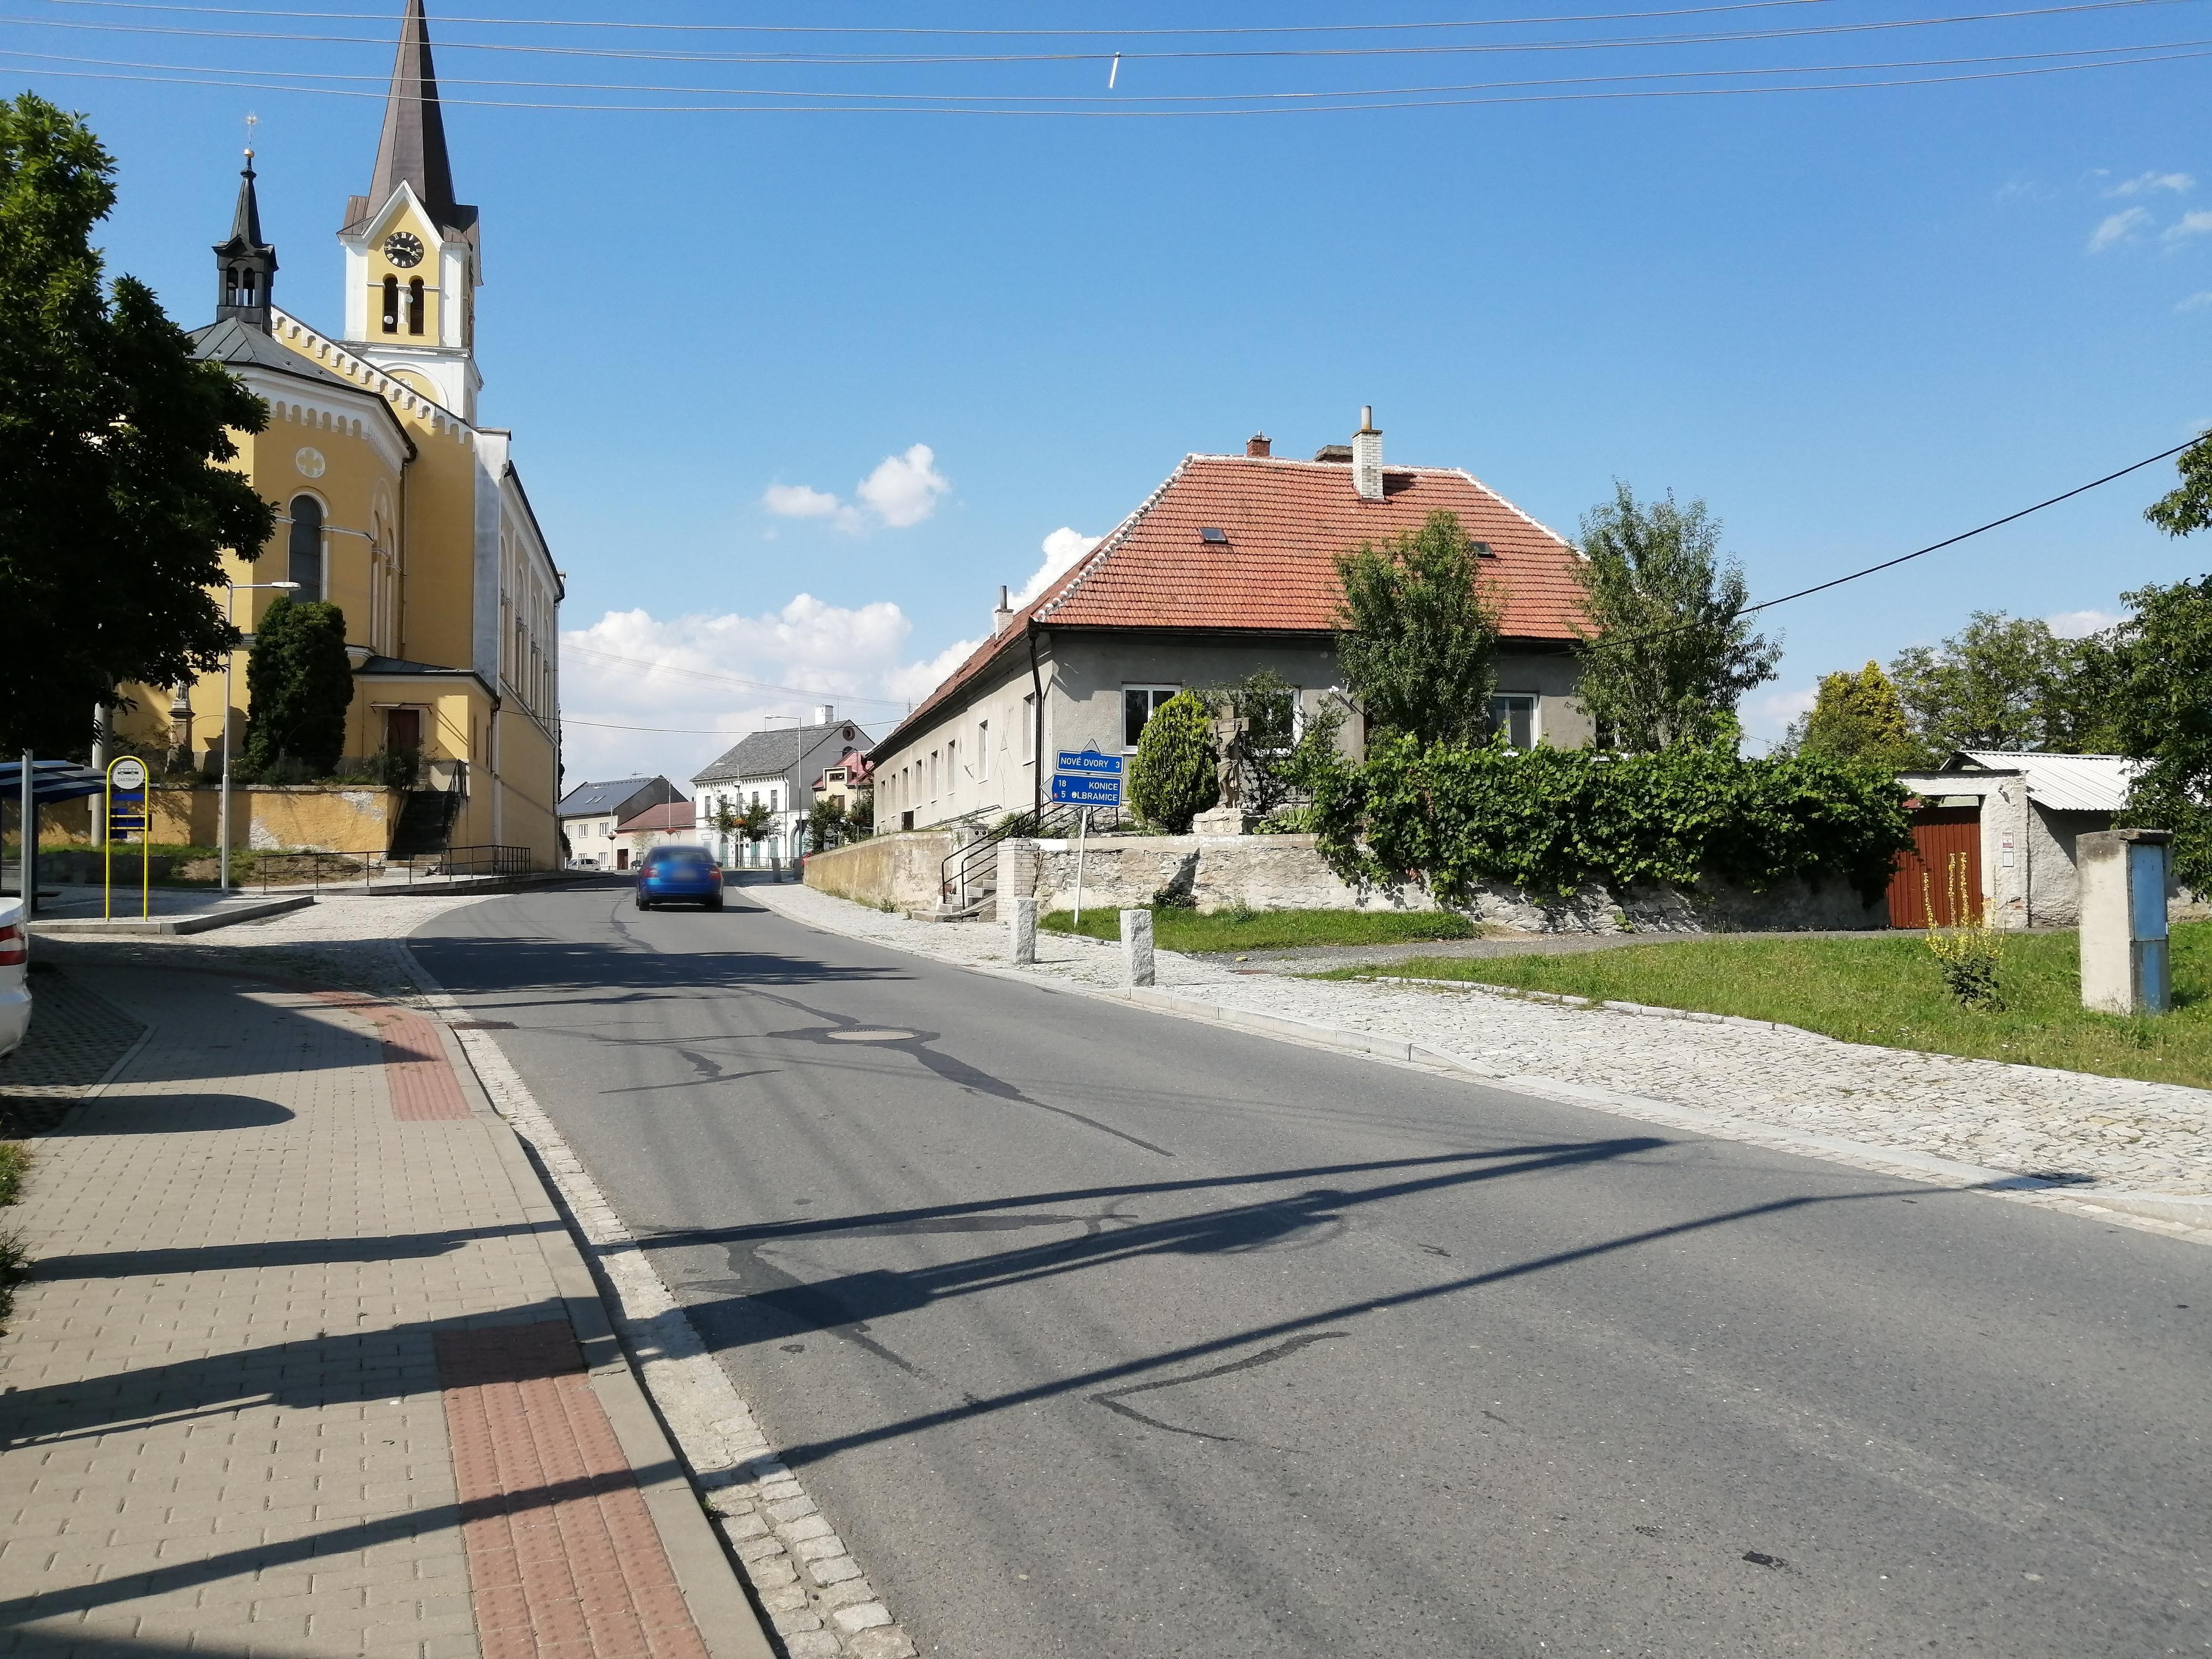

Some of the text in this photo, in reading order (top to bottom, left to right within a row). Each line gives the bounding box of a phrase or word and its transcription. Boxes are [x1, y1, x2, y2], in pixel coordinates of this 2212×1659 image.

[1061, 757, 1081, 766] NOVÉ
[1084, 759, 1108, 768] DVORY
[1058, 779, 1118, 791] 18 KONICE
